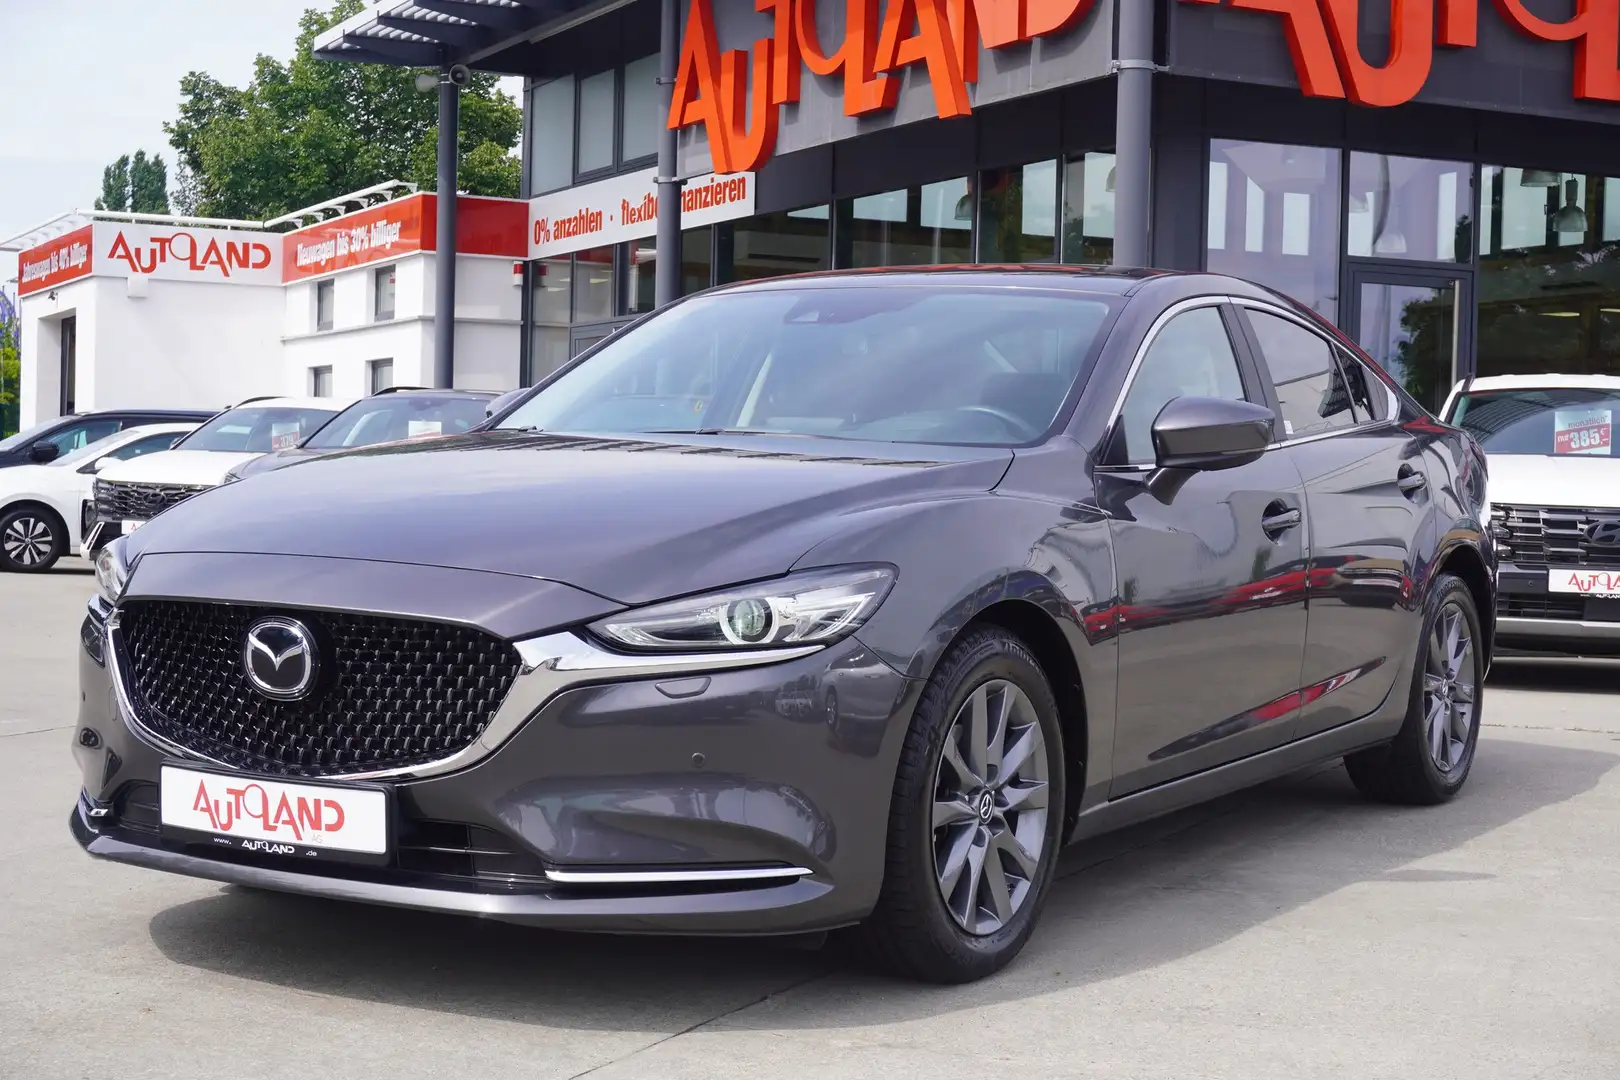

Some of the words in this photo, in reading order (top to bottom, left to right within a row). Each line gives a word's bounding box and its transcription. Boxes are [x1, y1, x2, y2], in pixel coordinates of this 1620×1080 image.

[534, 217, 550, 245] 0%
[553, 207, 603, 240] anzahlen
[621, 192, 658, 225] flexib
[680, 176, 746, 212] nanzieren
[107, 231, 271, 277] AUTOLAND
[336, 231, 349, 256] bis
[351, 225, 369, 252] 30%
[193, 779, 345, 840] AUTOLAND
[213, 837, 232, 845] www.
[242, 840, 295, 855] AUTOLAND
